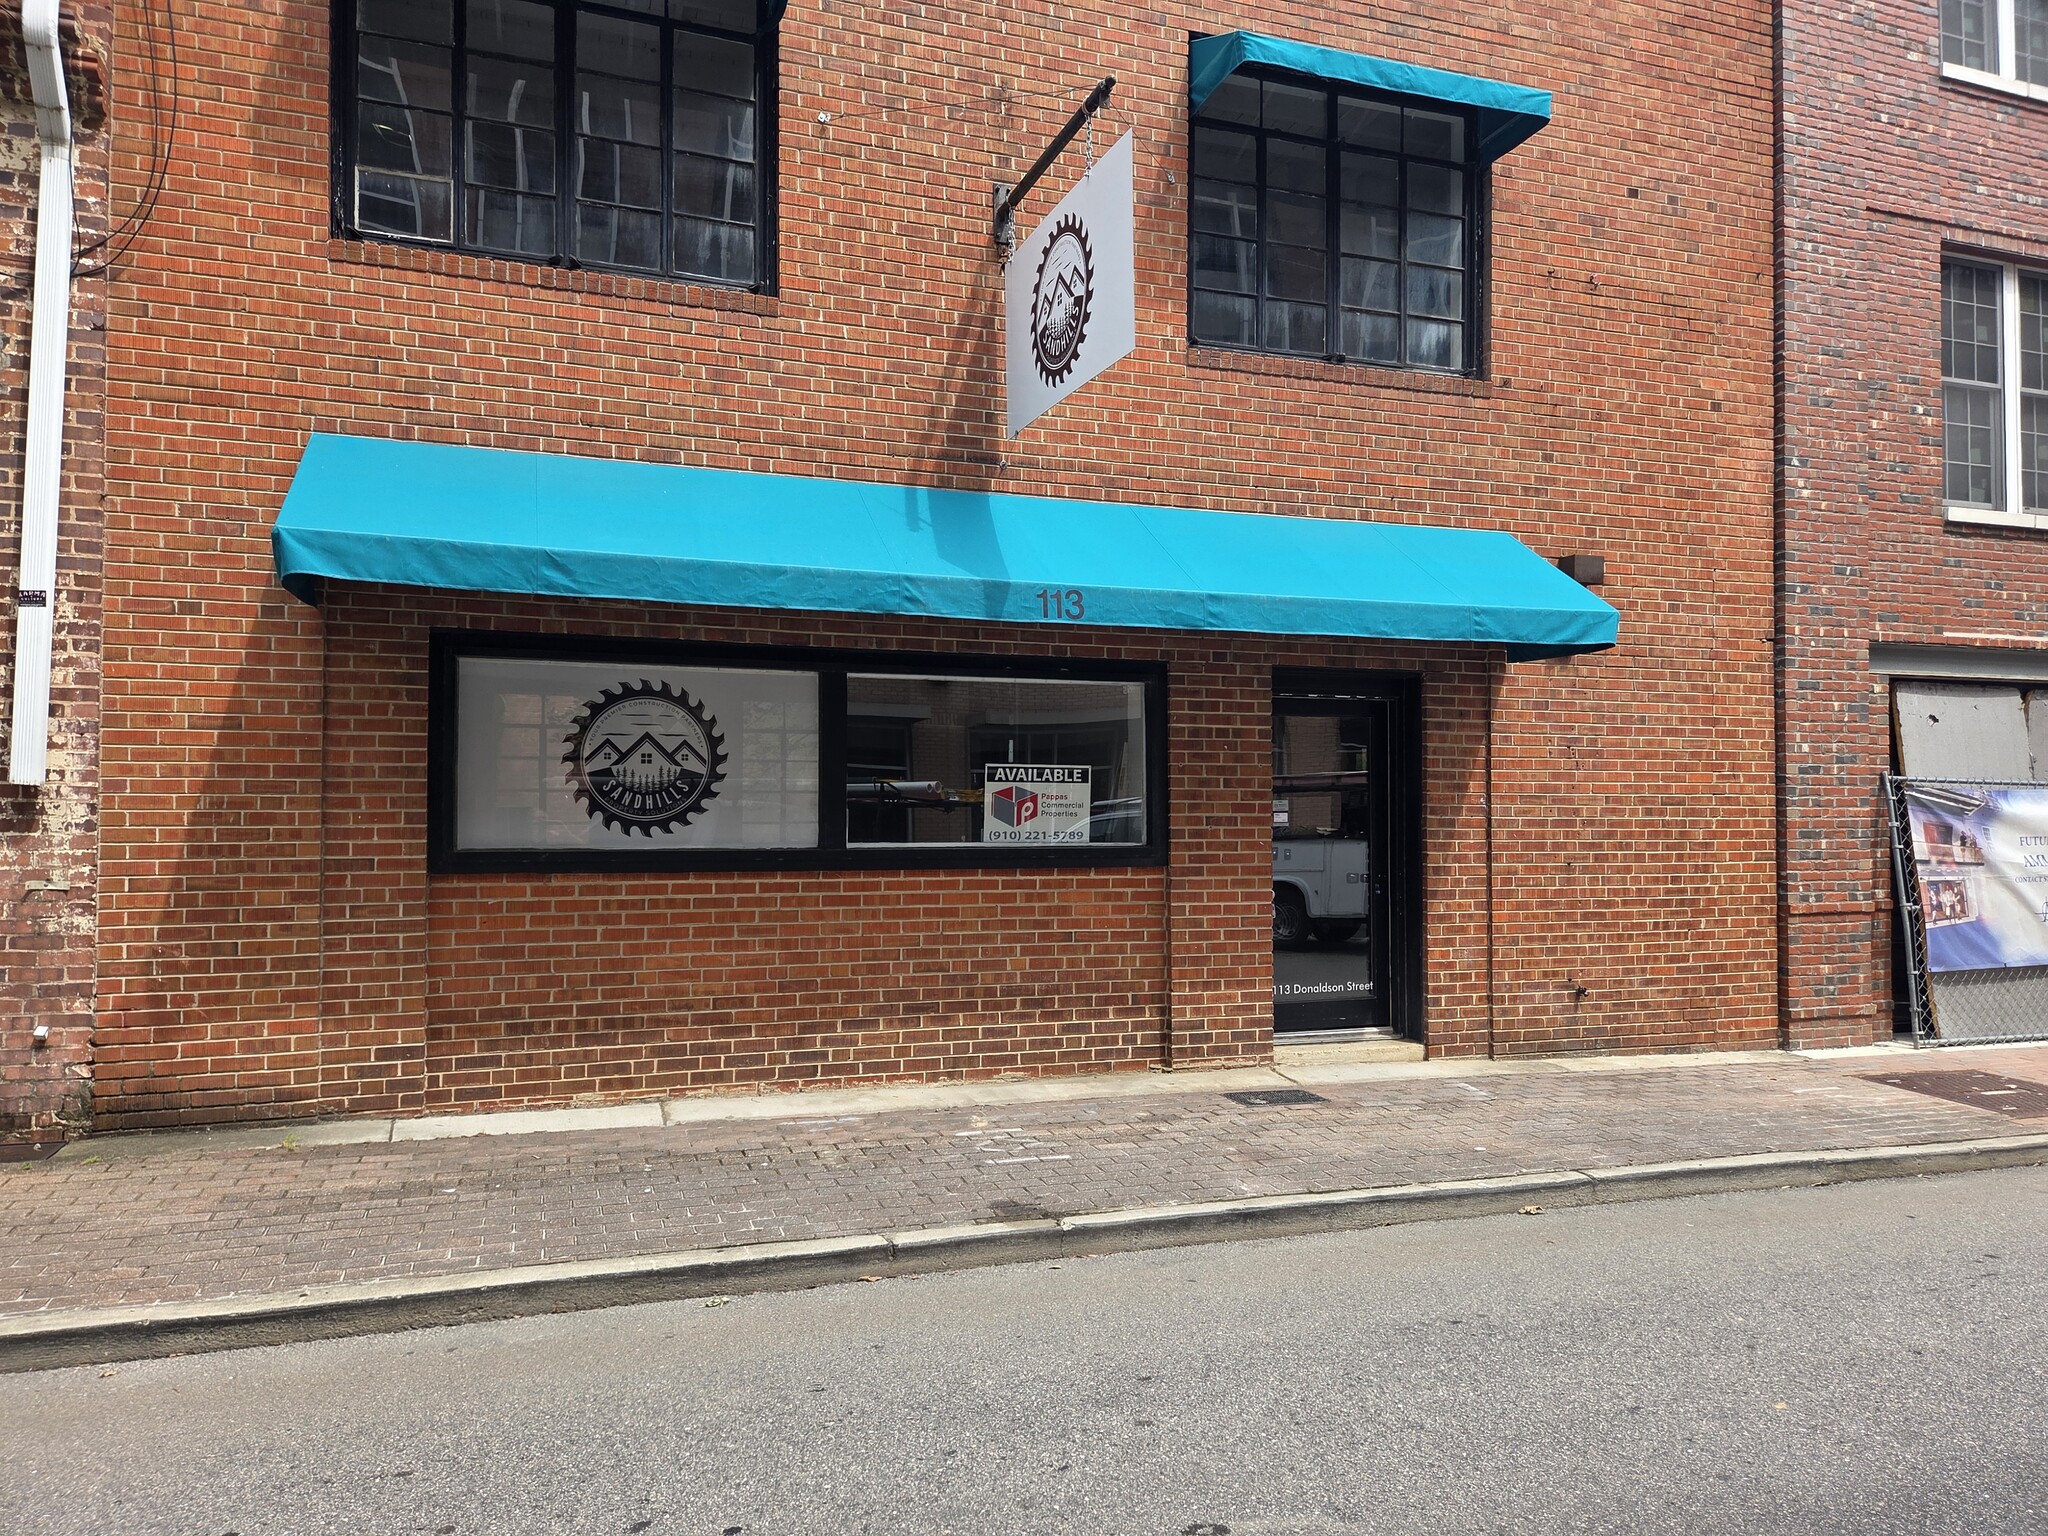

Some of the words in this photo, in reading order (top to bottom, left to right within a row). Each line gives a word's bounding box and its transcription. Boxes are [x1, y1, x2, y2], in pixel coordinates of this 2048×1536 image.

[1042, 306, 1079, 356] SANDHILLS
[1036, 589, 1085, 620] 113
[589, 724, 602, 742] YOUR
[600, 705, 627, 725] PREMIER
[628, 700, 681, 716] CONSTRUCTION
[680, 714, 704, 744] PARTNERS
[994, 767, 1082, 782] AVAILABLE
[602, 779, 689, 809] SANDHILLS
[1041, 792, 1068, 801] Pappas
[604, 796, 643, 816] PROPERTY
[645, 797, 688, 816] SOLUTIONS
[1041, 801, 1084, 809] Commercial
[1041, 809, 1078, 819] Properties
[988, 830, 1022, 841] (910)
[2014, 875, 2043, 883] CONTACT
[1293, 982, 1344, 994] Donaldson
[1346, 980, 1374, 991] Street
